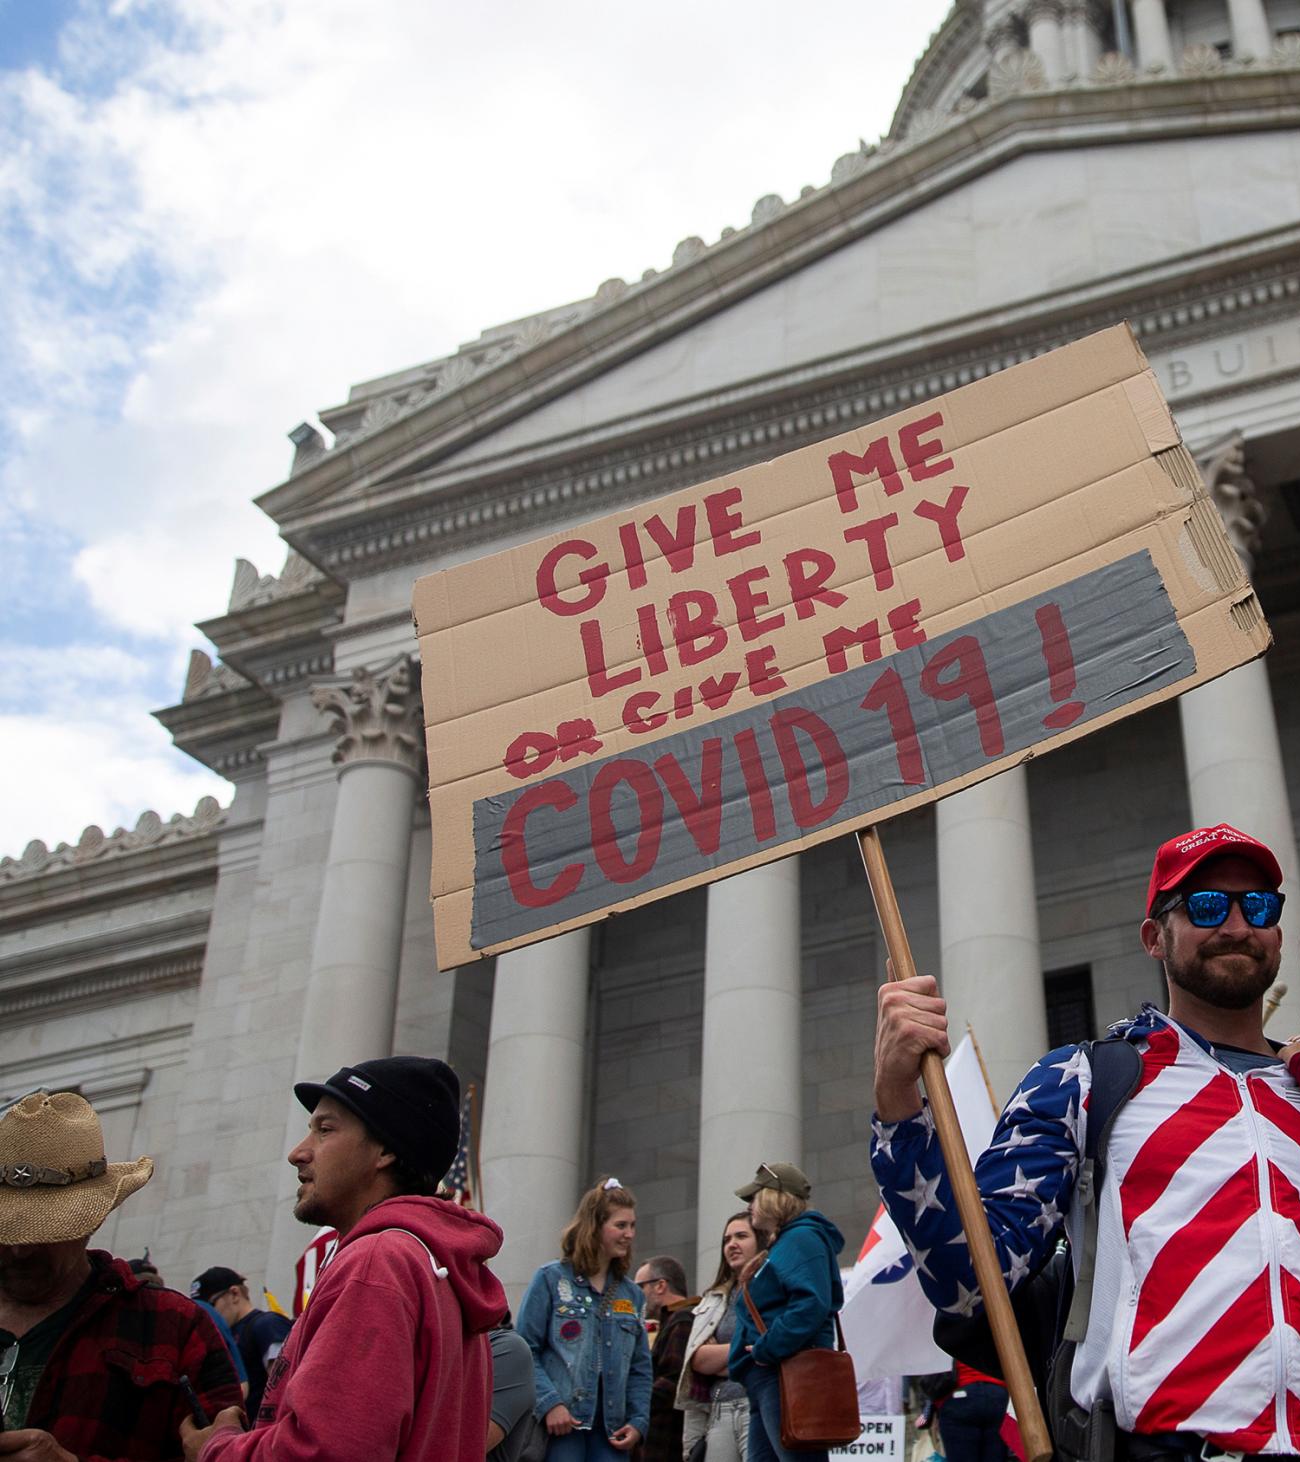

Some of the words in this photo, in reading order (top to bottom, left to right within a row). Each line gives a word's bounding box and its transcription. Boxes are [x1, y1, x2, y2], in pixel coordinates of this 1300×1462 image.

[536, 487, 761, 618] GIVE
[828, 412, 955, 514] ME
[580, 486, 969, 699] LIBERTY
[503, 717, 604, 779] OR
[622, 645, 788, 734] GIVE
[825, 598, 927, 674] ME
[501, 707, 850, 908] COVID
[1181, 832, 1218, 854] GREAT
